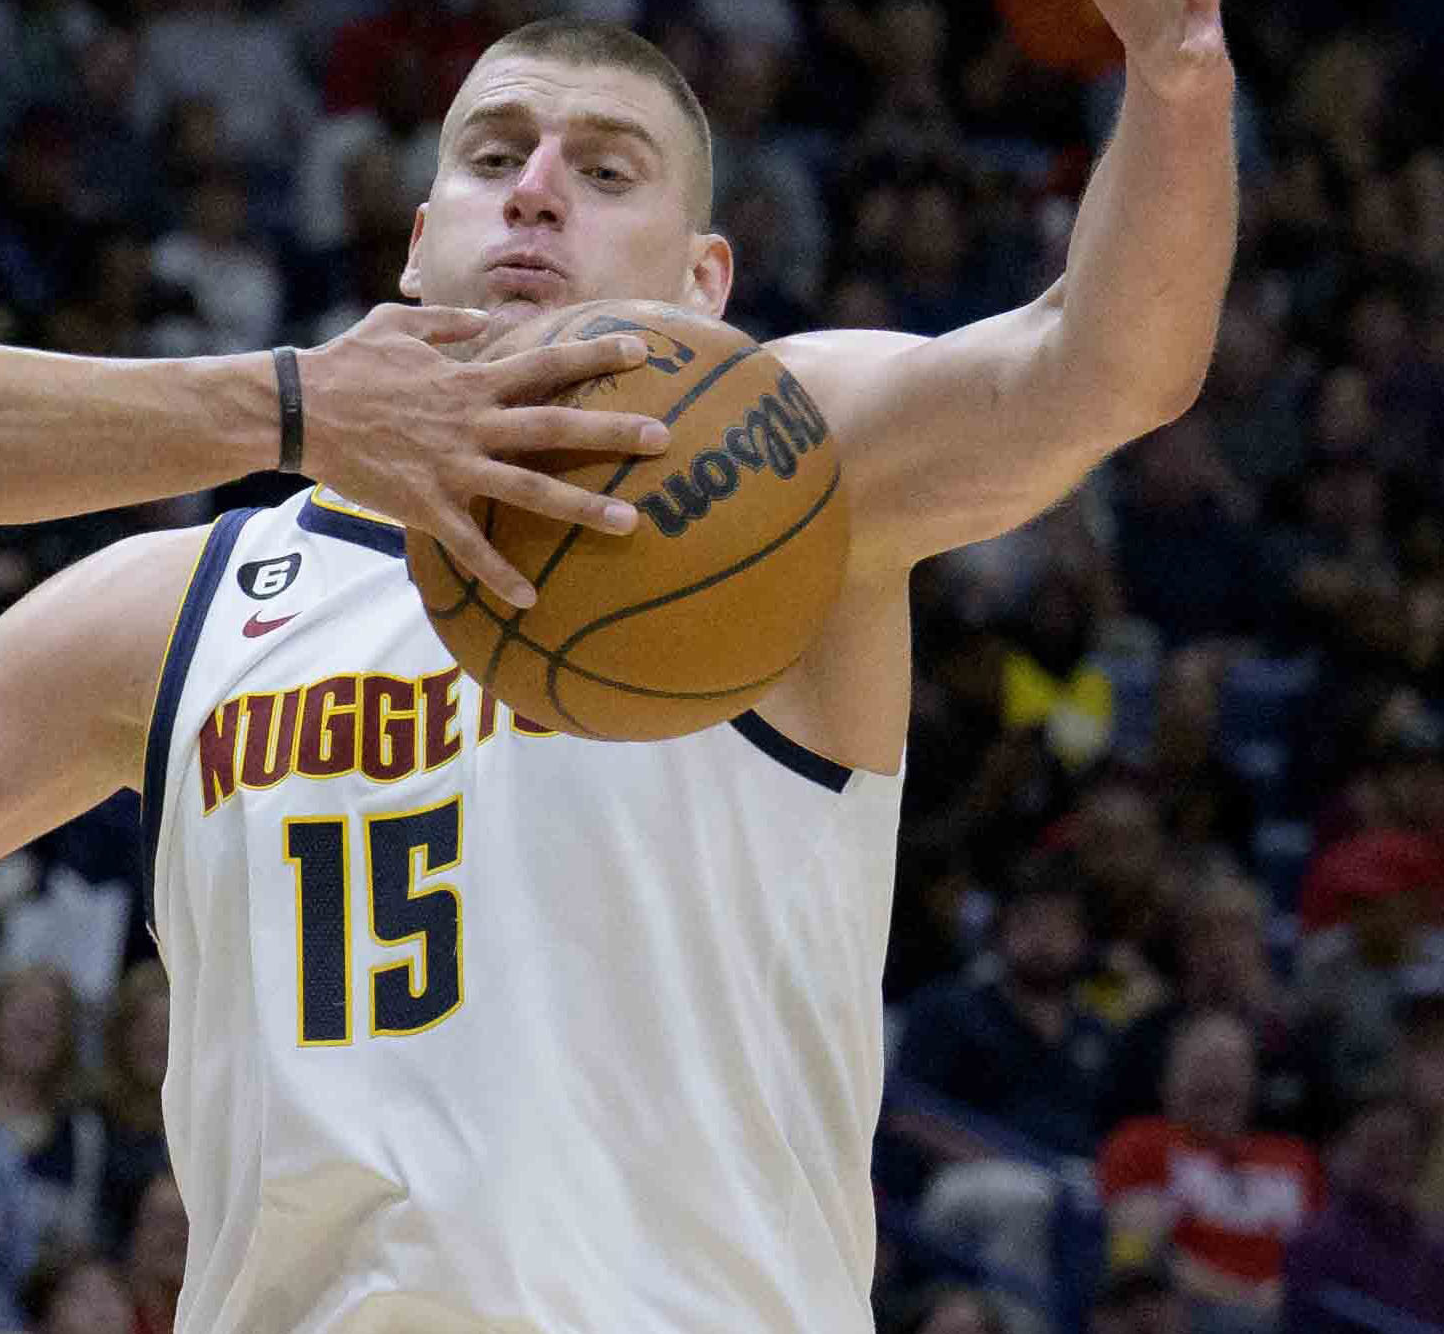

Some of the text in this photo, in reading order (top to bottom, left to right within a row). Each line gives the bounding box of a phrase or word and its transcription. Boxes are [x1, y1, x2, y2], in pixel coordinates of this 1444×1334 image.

[251, 560, 292, 596] 6
[198, 662, 562, 818] NUGGE
[283, 795, 464, 1048] 15
